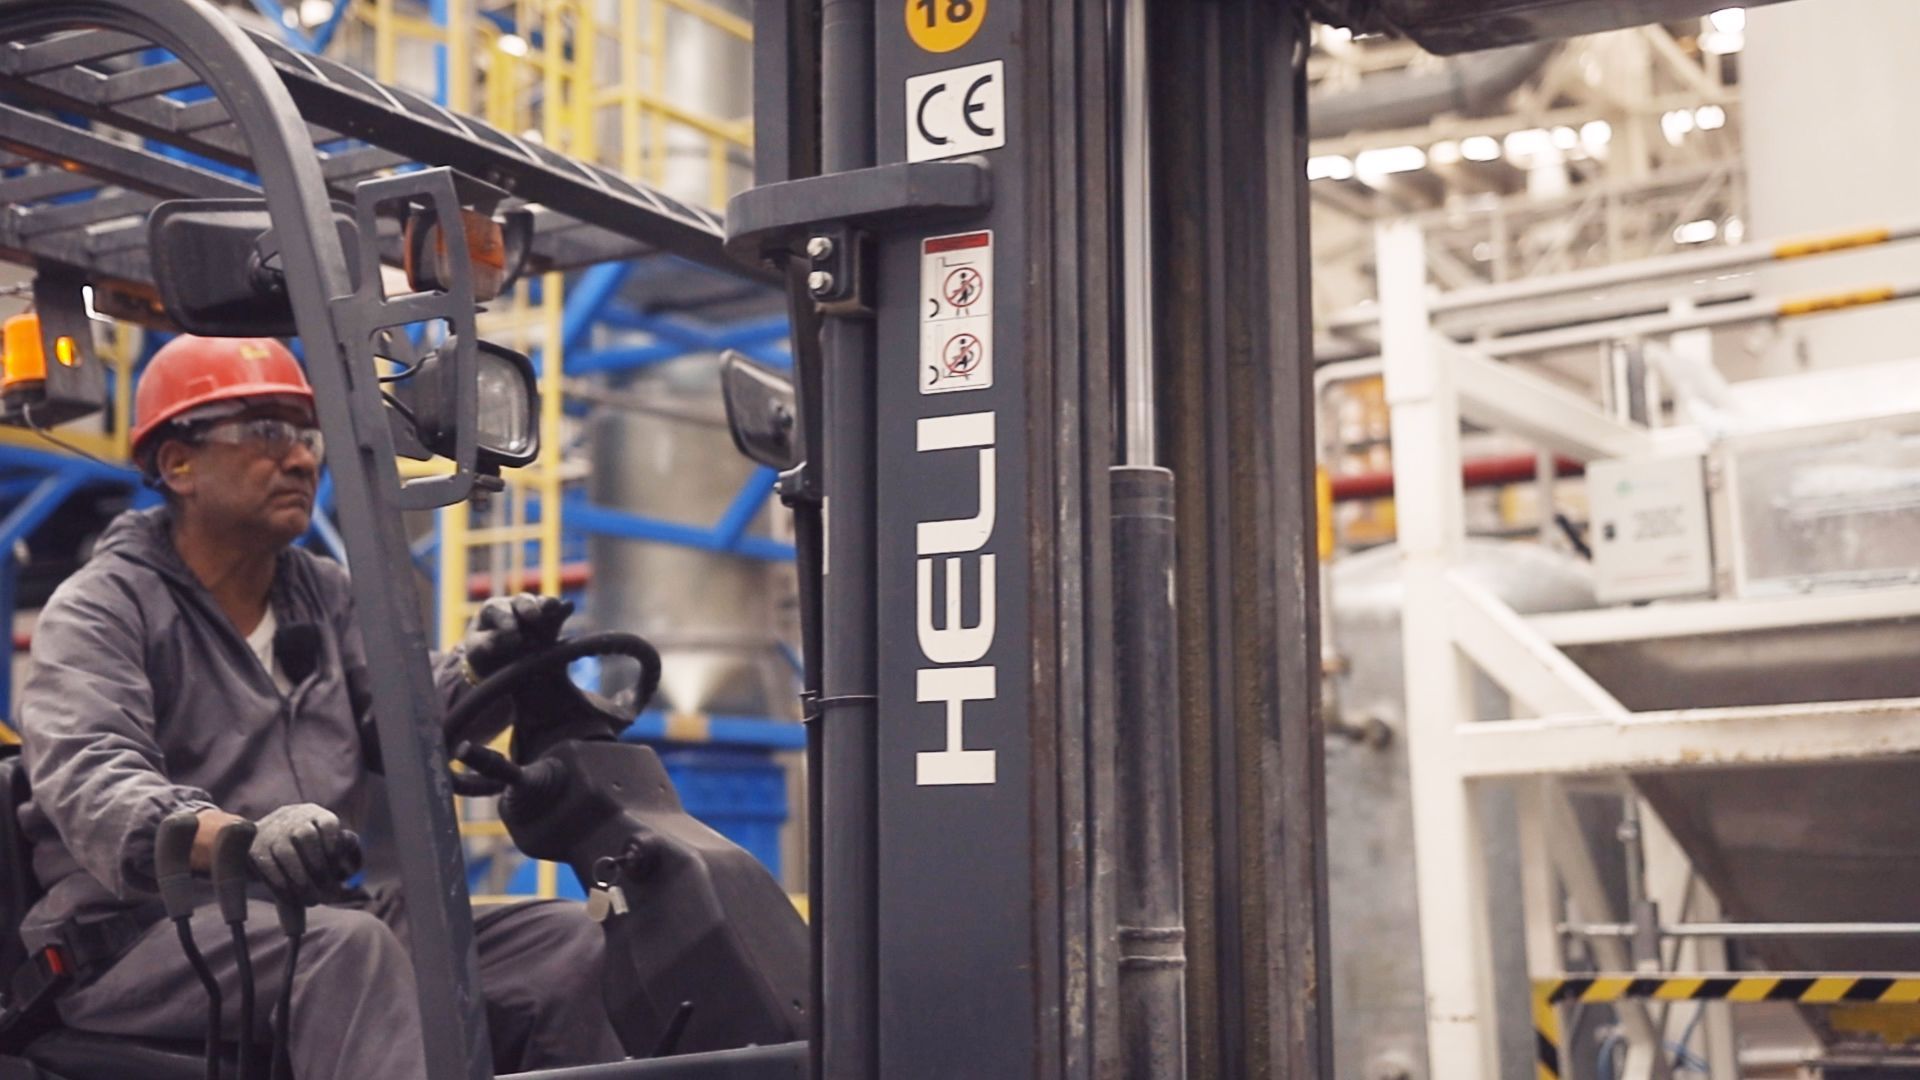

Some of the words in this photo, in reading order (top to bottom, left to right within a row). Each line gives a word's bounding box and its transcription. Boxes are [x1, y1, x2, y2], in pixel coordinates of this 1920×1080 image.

[916, 0, 973, 27] 18
[917, 74, 994, 145] CE
[916, 411, 996, 785] HELI
